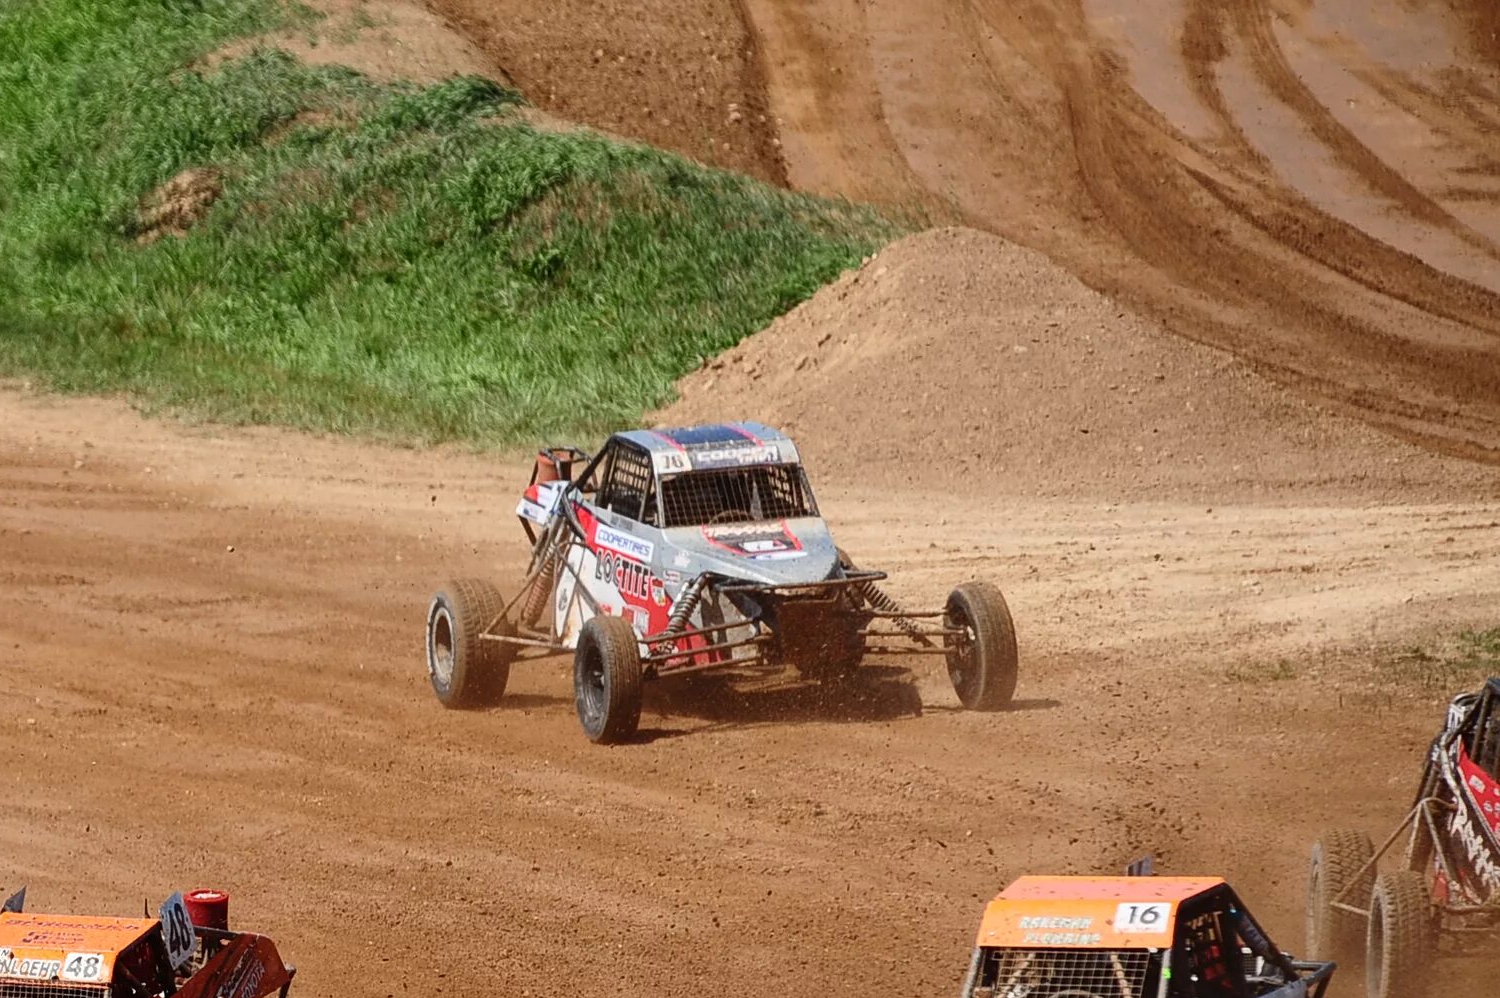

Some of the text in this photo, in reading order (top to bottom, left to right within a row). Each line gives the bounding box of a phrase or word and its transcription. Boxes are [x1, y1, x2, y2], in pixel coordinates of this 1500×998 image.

[595, 548, 651, 600] LOCTITE
[168, 902, 191, 957] 48
[1128, 905, 1161, 925] 16
[65, 955, 101, 978] 48
